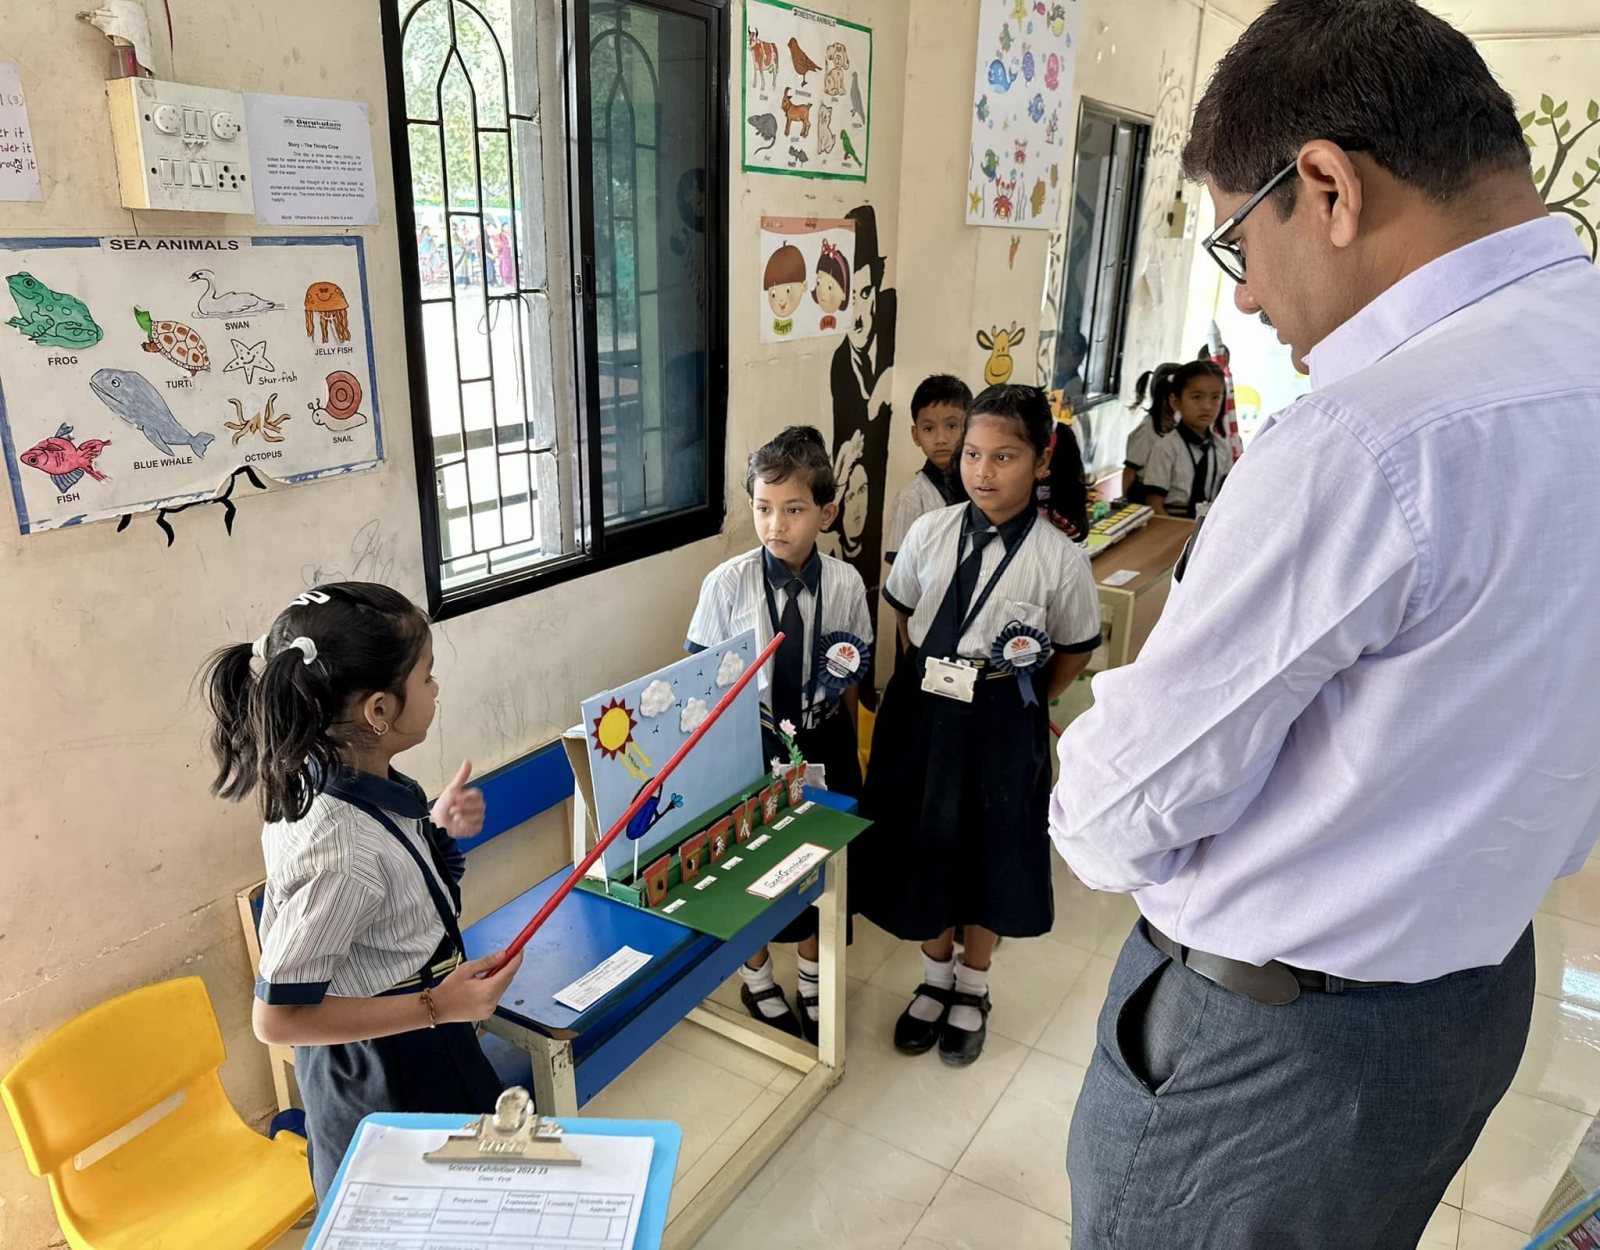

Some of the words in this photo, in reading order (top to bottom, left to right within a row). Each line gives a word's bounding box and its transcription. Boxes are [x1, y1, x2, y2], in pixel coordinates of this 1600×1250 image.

[296, 118, 342, 127] Gurukulam
[14, 127, 25, 139] it
[22, 142, 32, 153] it
[27, 159, 36, 170] it
[109, 239, 152, 251] SEA
[156, 239, 239, 251] ANIMALS
[224, 321, 250, 331] SWAN
[314, 347, 336, 356] JELLY
[337, 346, 354, 354] FISH
[47, 355, 79, 366] FROG
[332, 435, 354, 444] SNAIL
[244, 450, 283, 463] OCTOPUS
[133, 457, 159, 470] BLUE
[160, 456, 193, 468] WHALE
[56, 492, 81, 504] FISH
